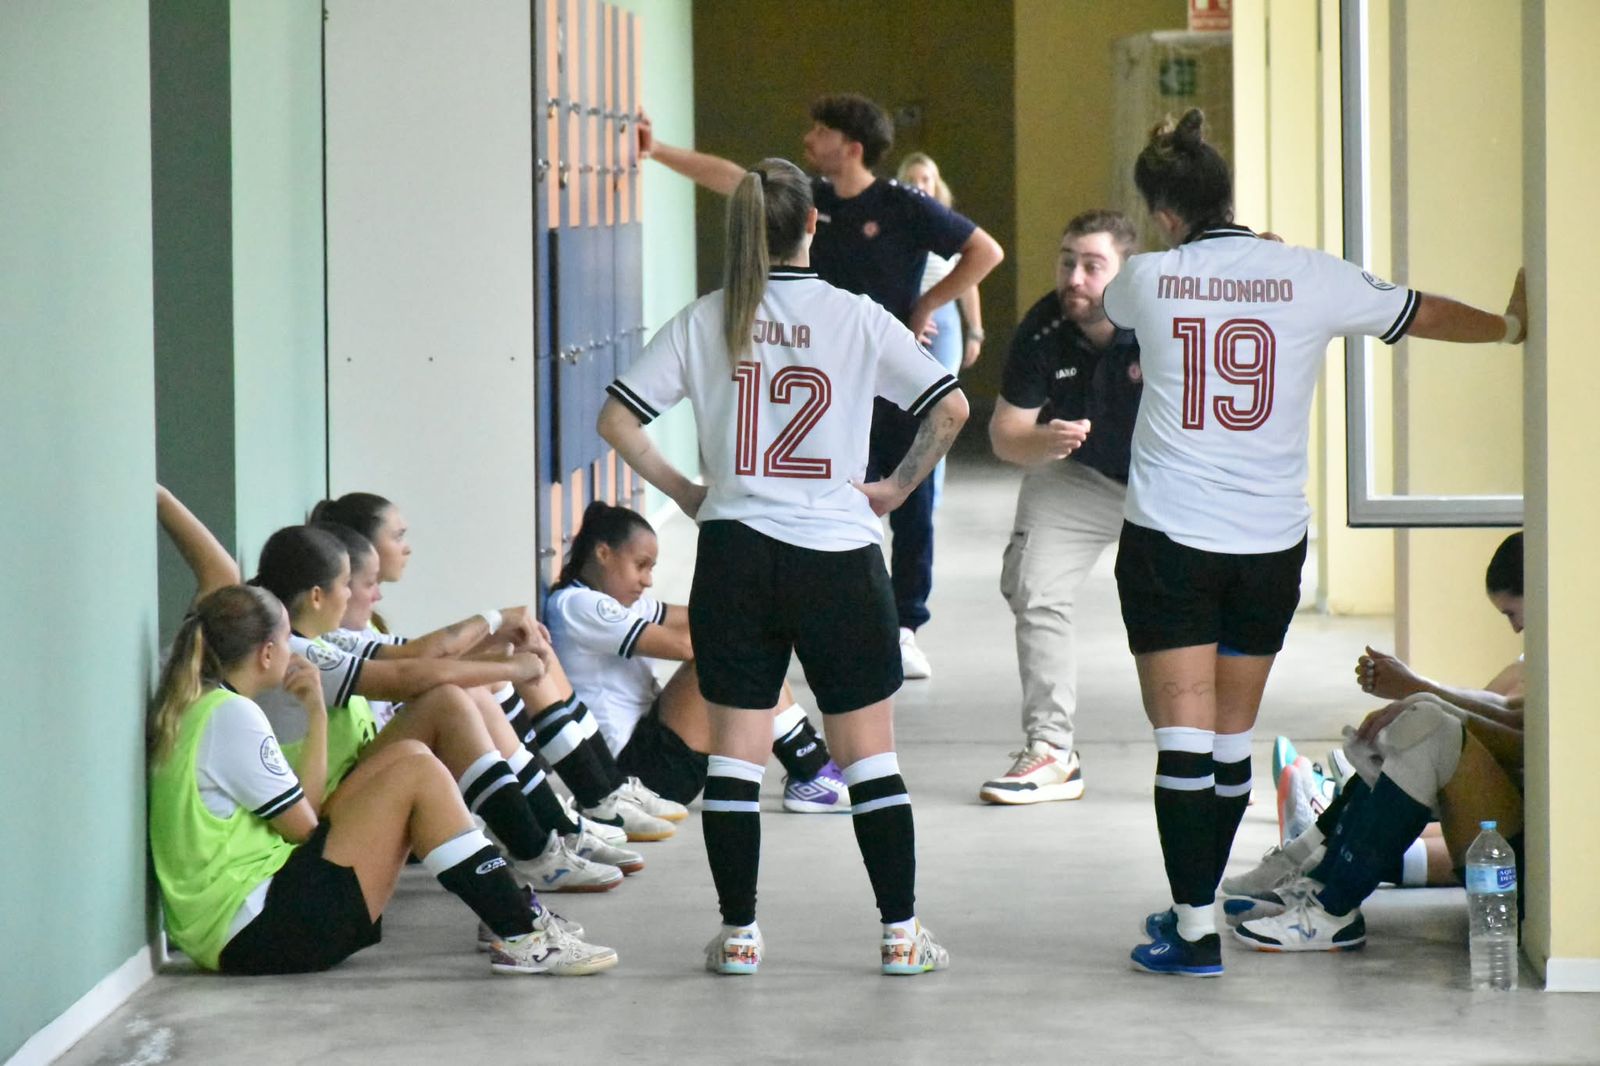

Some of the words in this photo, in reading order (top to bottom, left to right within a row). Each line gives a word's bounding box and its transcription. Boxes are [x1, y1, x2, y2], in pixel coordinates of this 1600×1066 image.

[1157, 274, 1293, 303] MALDONADO
[752, 319, 811, 349] JULIA
[1172, 317, 1277, 432] 19
[731, 360, 832, 479] 12
